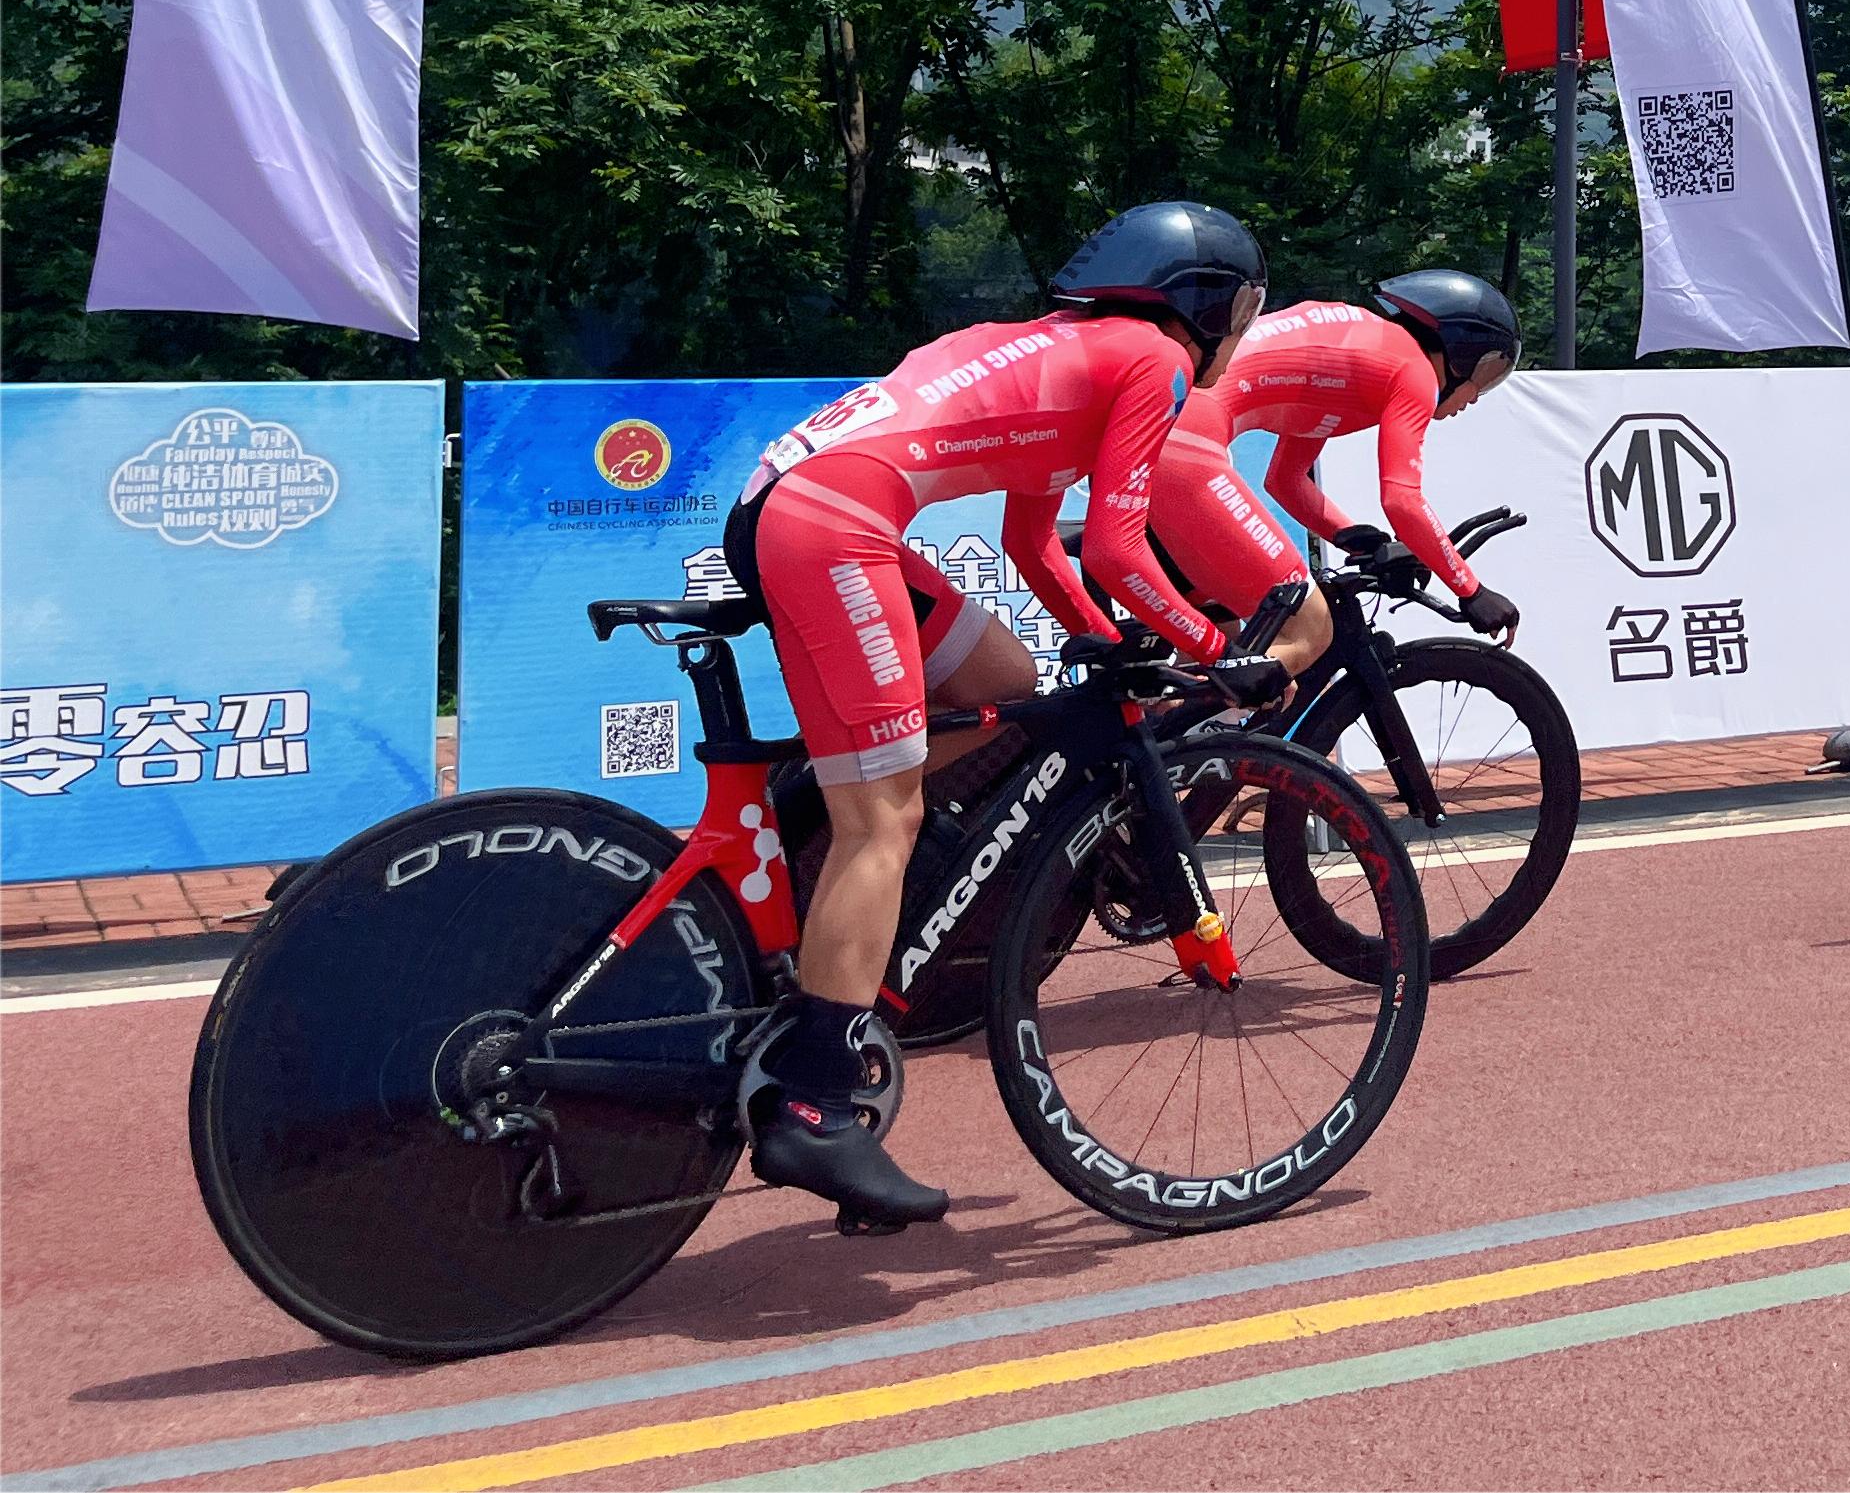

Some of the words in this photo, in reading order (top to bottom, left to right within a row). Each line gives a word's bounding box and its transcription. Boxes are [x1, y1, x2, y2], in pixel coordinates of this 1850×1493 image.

[984, 332, 1054, 370] HONG
[915, 359, 990, 405] KONG
[1258, 373, 1307, 386] Champion
[1311, 374, 1346, 388] System
[187, 418, 239, 445] 公平
[934, 434, 1004, 455] Champion
[1009, 427, 1058, 445] System
[165, 447, 236, 463] Fairplay
[162, 463, 278, 491] 纯洁体育
[161, 492, 216, 509] CLEAN
[219, 490, 276, 507] SPORT
[547, 494, 718, 516] 中国自行车运动协会
[1599, 428, 1721, 562] MG
[163, 511, 219, 528] Rules
[219, 508, 277, 532] 规则
[547, 522, 598, 532] CHINESE
[599, 519, 644, 530] CYCLING
[645, 516, 719, 528] ASSOCIATION
[1207, 474, 1251, 521] HONG
[1242, 514, 1285, 560] KONG
[1121, 572, 1170, 613] HONG
[828, 561, 876, 623] HONG
[856, 622, 905, 687] KONG
[1139, 635, 1160, 650] 3T
[1606, 598, 1749, 684] 名爵
[0, 683, 310, 796] 零容忍
[869, 709, 924, 745] HKG
[1017, 1018, 1364, 1208] CAMPAGNOLO
